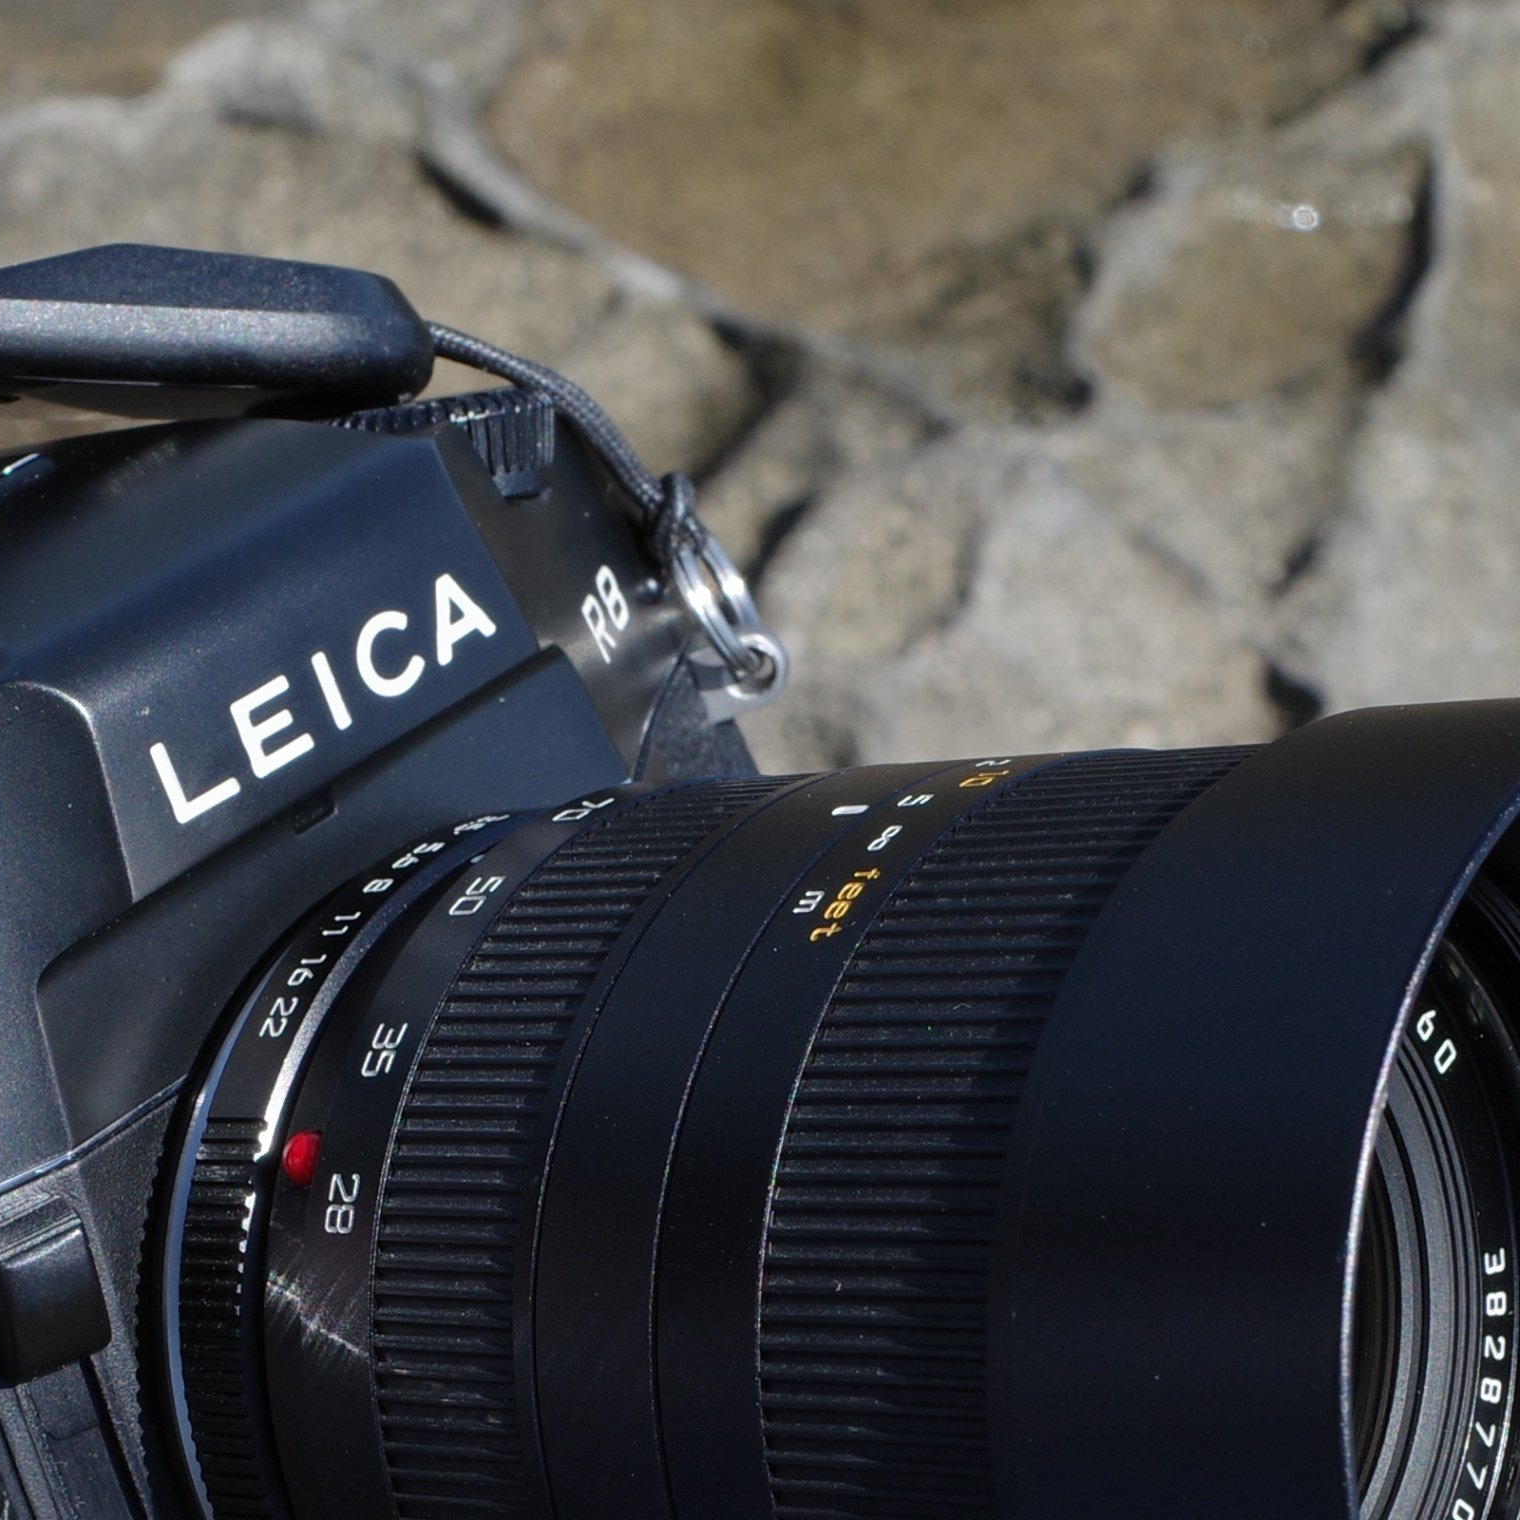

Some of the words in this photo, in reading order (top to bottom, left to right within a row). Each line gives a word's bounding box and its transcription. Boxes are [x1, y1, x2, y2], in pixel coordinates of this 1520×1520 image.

[580, 564, 630, 664] R8
[149, 572, 496, 824] LEICA
[957, 769, 1010, 788] 10
[551, 797, 616, 822] 70
[896, 793, 935, 808] 5
[362, 878, 394, 894] 8
[448, 875, 506, 916] 50
[792, 890, 825, 914] m
[809, 868, 881, 942] feet
[287, 953, 328, 987] 16
[259, 996, 298, 1039] 22
[360, 1021, 408, 1078] 35
[1416, 1009, 1458, 1075] 60
[324, 1172, 361, 1235] 28
